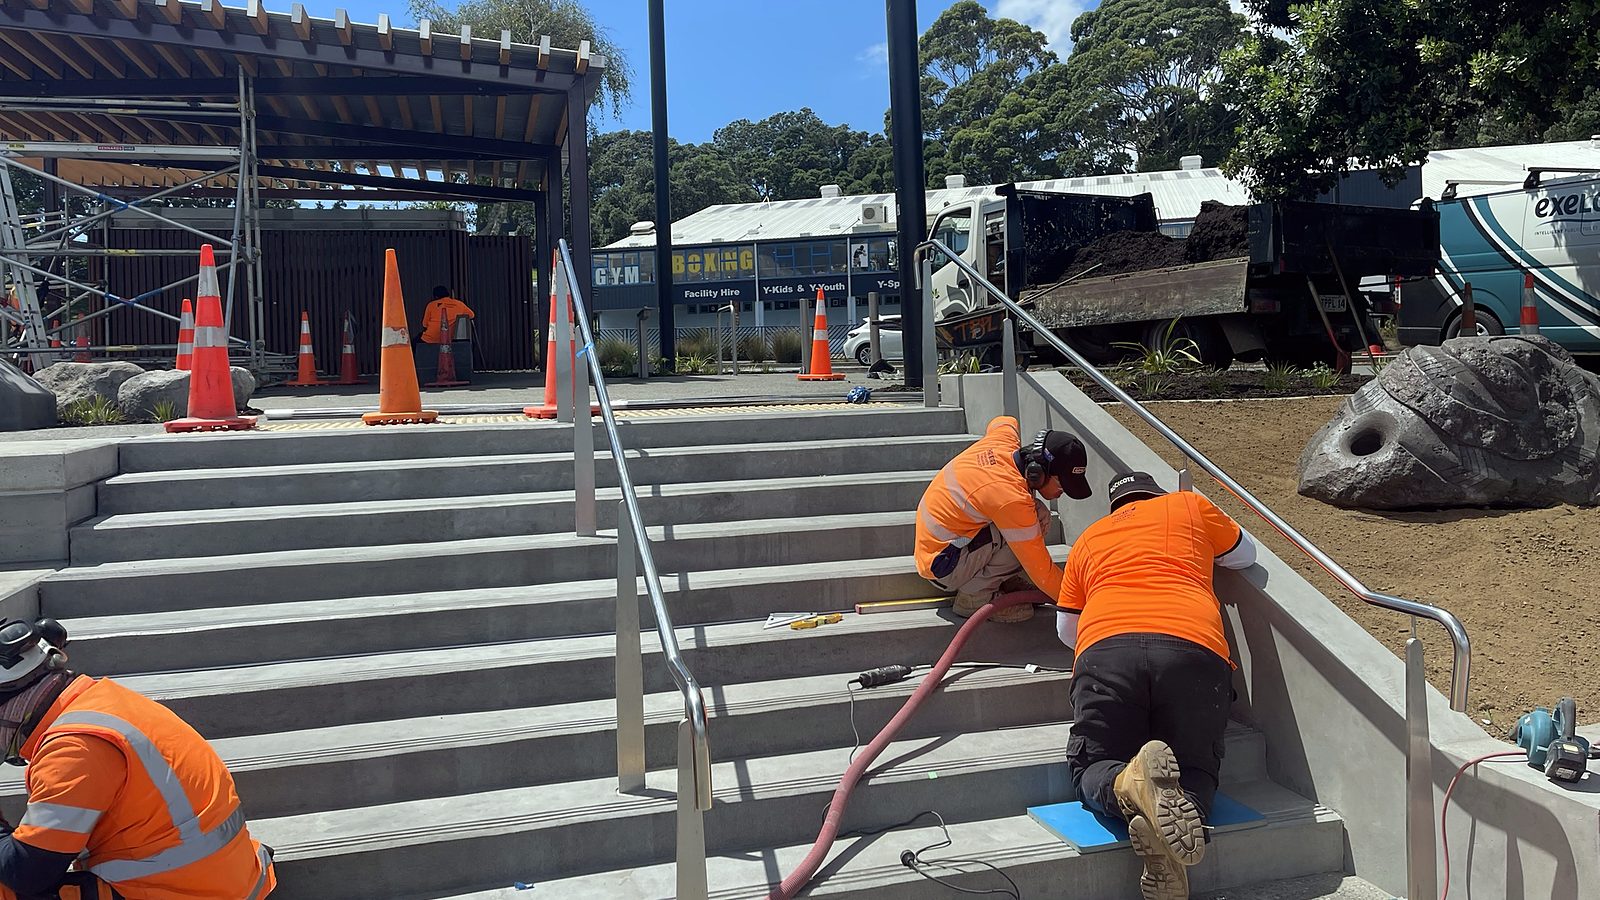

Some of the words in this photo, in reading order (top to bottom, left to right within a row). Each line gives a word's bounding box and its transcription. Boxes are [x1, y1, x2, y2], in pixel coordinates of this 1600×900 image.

[672, 250, 753, 274] BOXING
[595, 266, 639, 285] GYM
[684, 289, 718, 298] Facility
[720, 288, 741, 297] Hire
[763, 285, 793, 294] Y-Kids
[797, 284, 804, 292] &
[809, 282, 845, 291] Y-Youth
